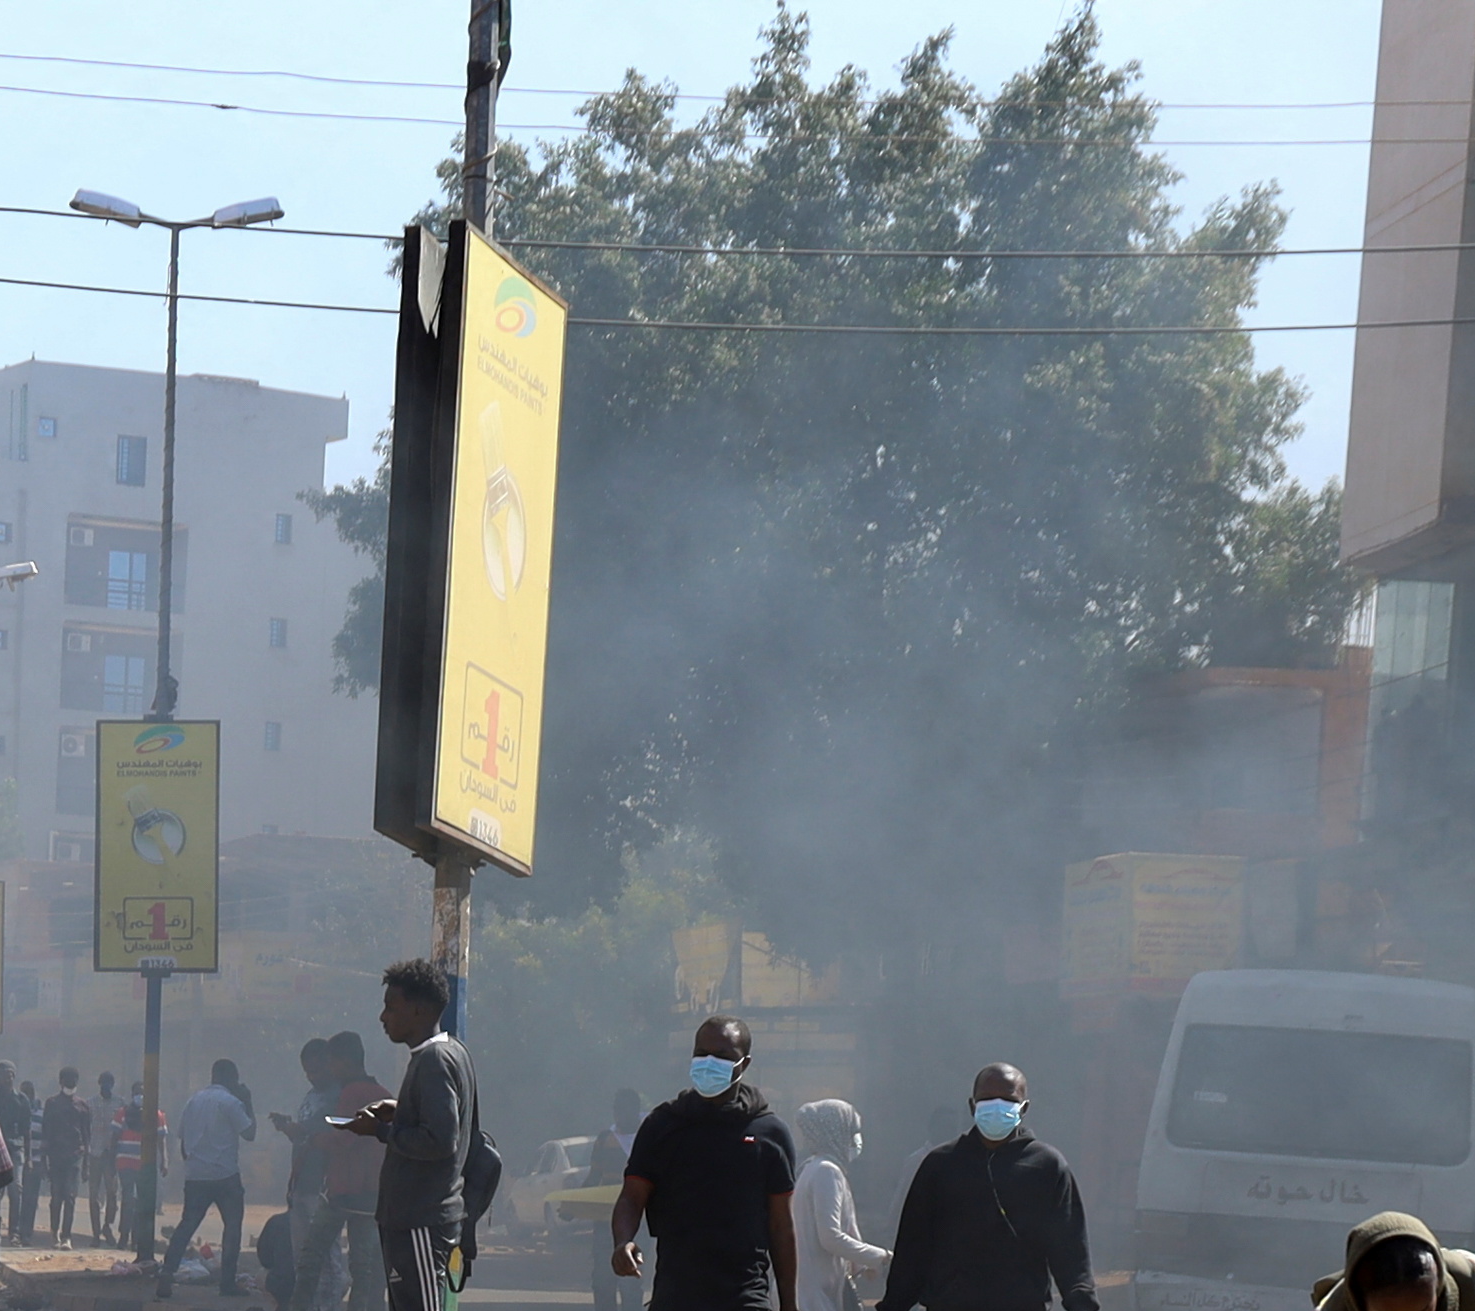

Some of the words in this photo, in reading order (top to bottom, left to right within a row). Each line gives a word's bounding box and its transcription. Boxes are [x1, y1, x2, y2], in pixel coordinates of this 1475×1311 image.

[477, 333, 518, 375] المهندس
[481, 687, 501, 781] 1
[116, 758, 165, 769] المهندس
[116, 770, 167, 778] ELMOHANDIS
[169, 770, 197, 778] PAINTS
[165, 759, 203, 769] بوهيات
[459, 767, 499, 805] السودان
[147, 901, 170, 940] 1
[123, 940, 171, 955] السودان
